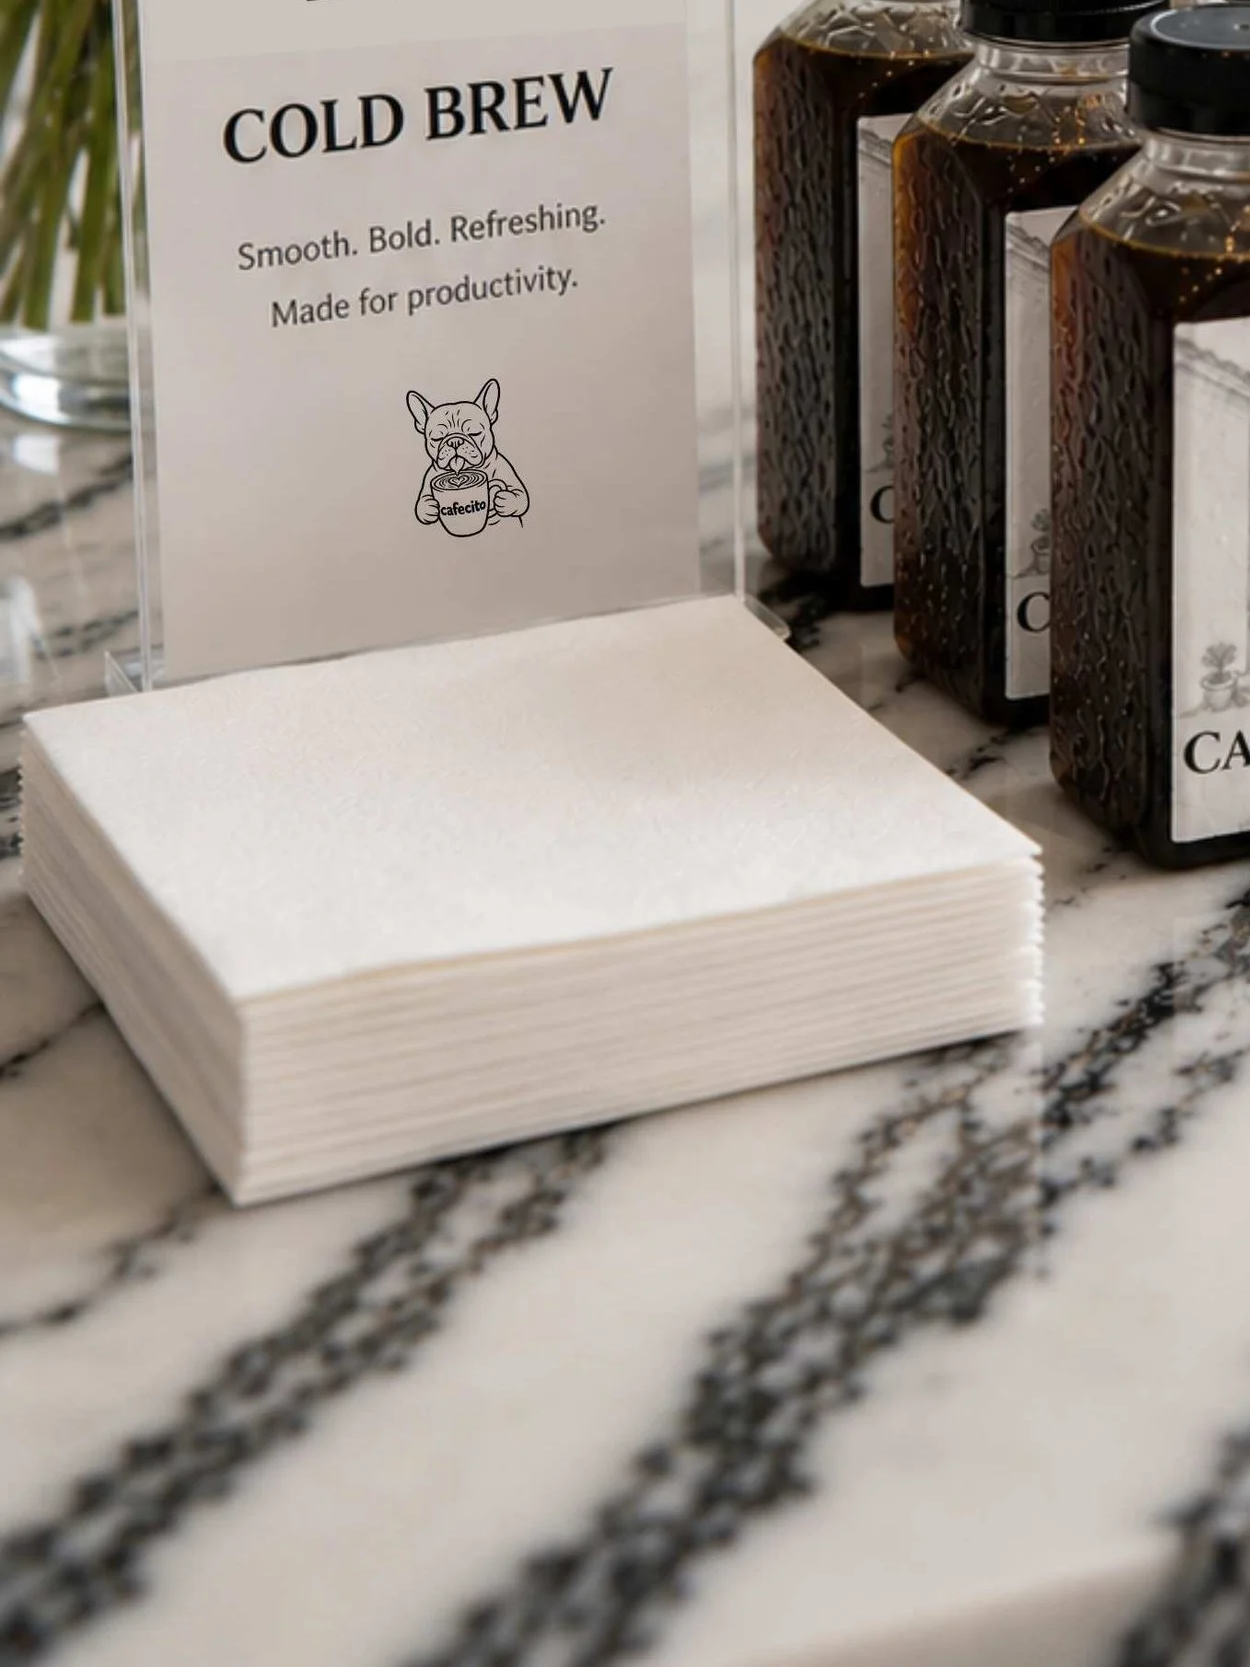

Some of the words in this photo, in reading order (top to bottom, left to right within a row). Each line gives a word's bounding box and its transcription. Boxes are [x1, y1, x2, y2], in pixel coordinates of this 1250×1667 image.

[223, 93, 404, 163] COLD
[424, 67, 613, 141] BREW
[238, 231, 358, 270] Smooth.
[369, 219, 441, 253] Bold.
[450, 203, 605, 243] Refreshing.
[271, 293, 350, 328] Made
[359, 288, 398, 316] for
[407, 265, 578, 315] productivity.
[441, 500, 486, 516] cafecito
